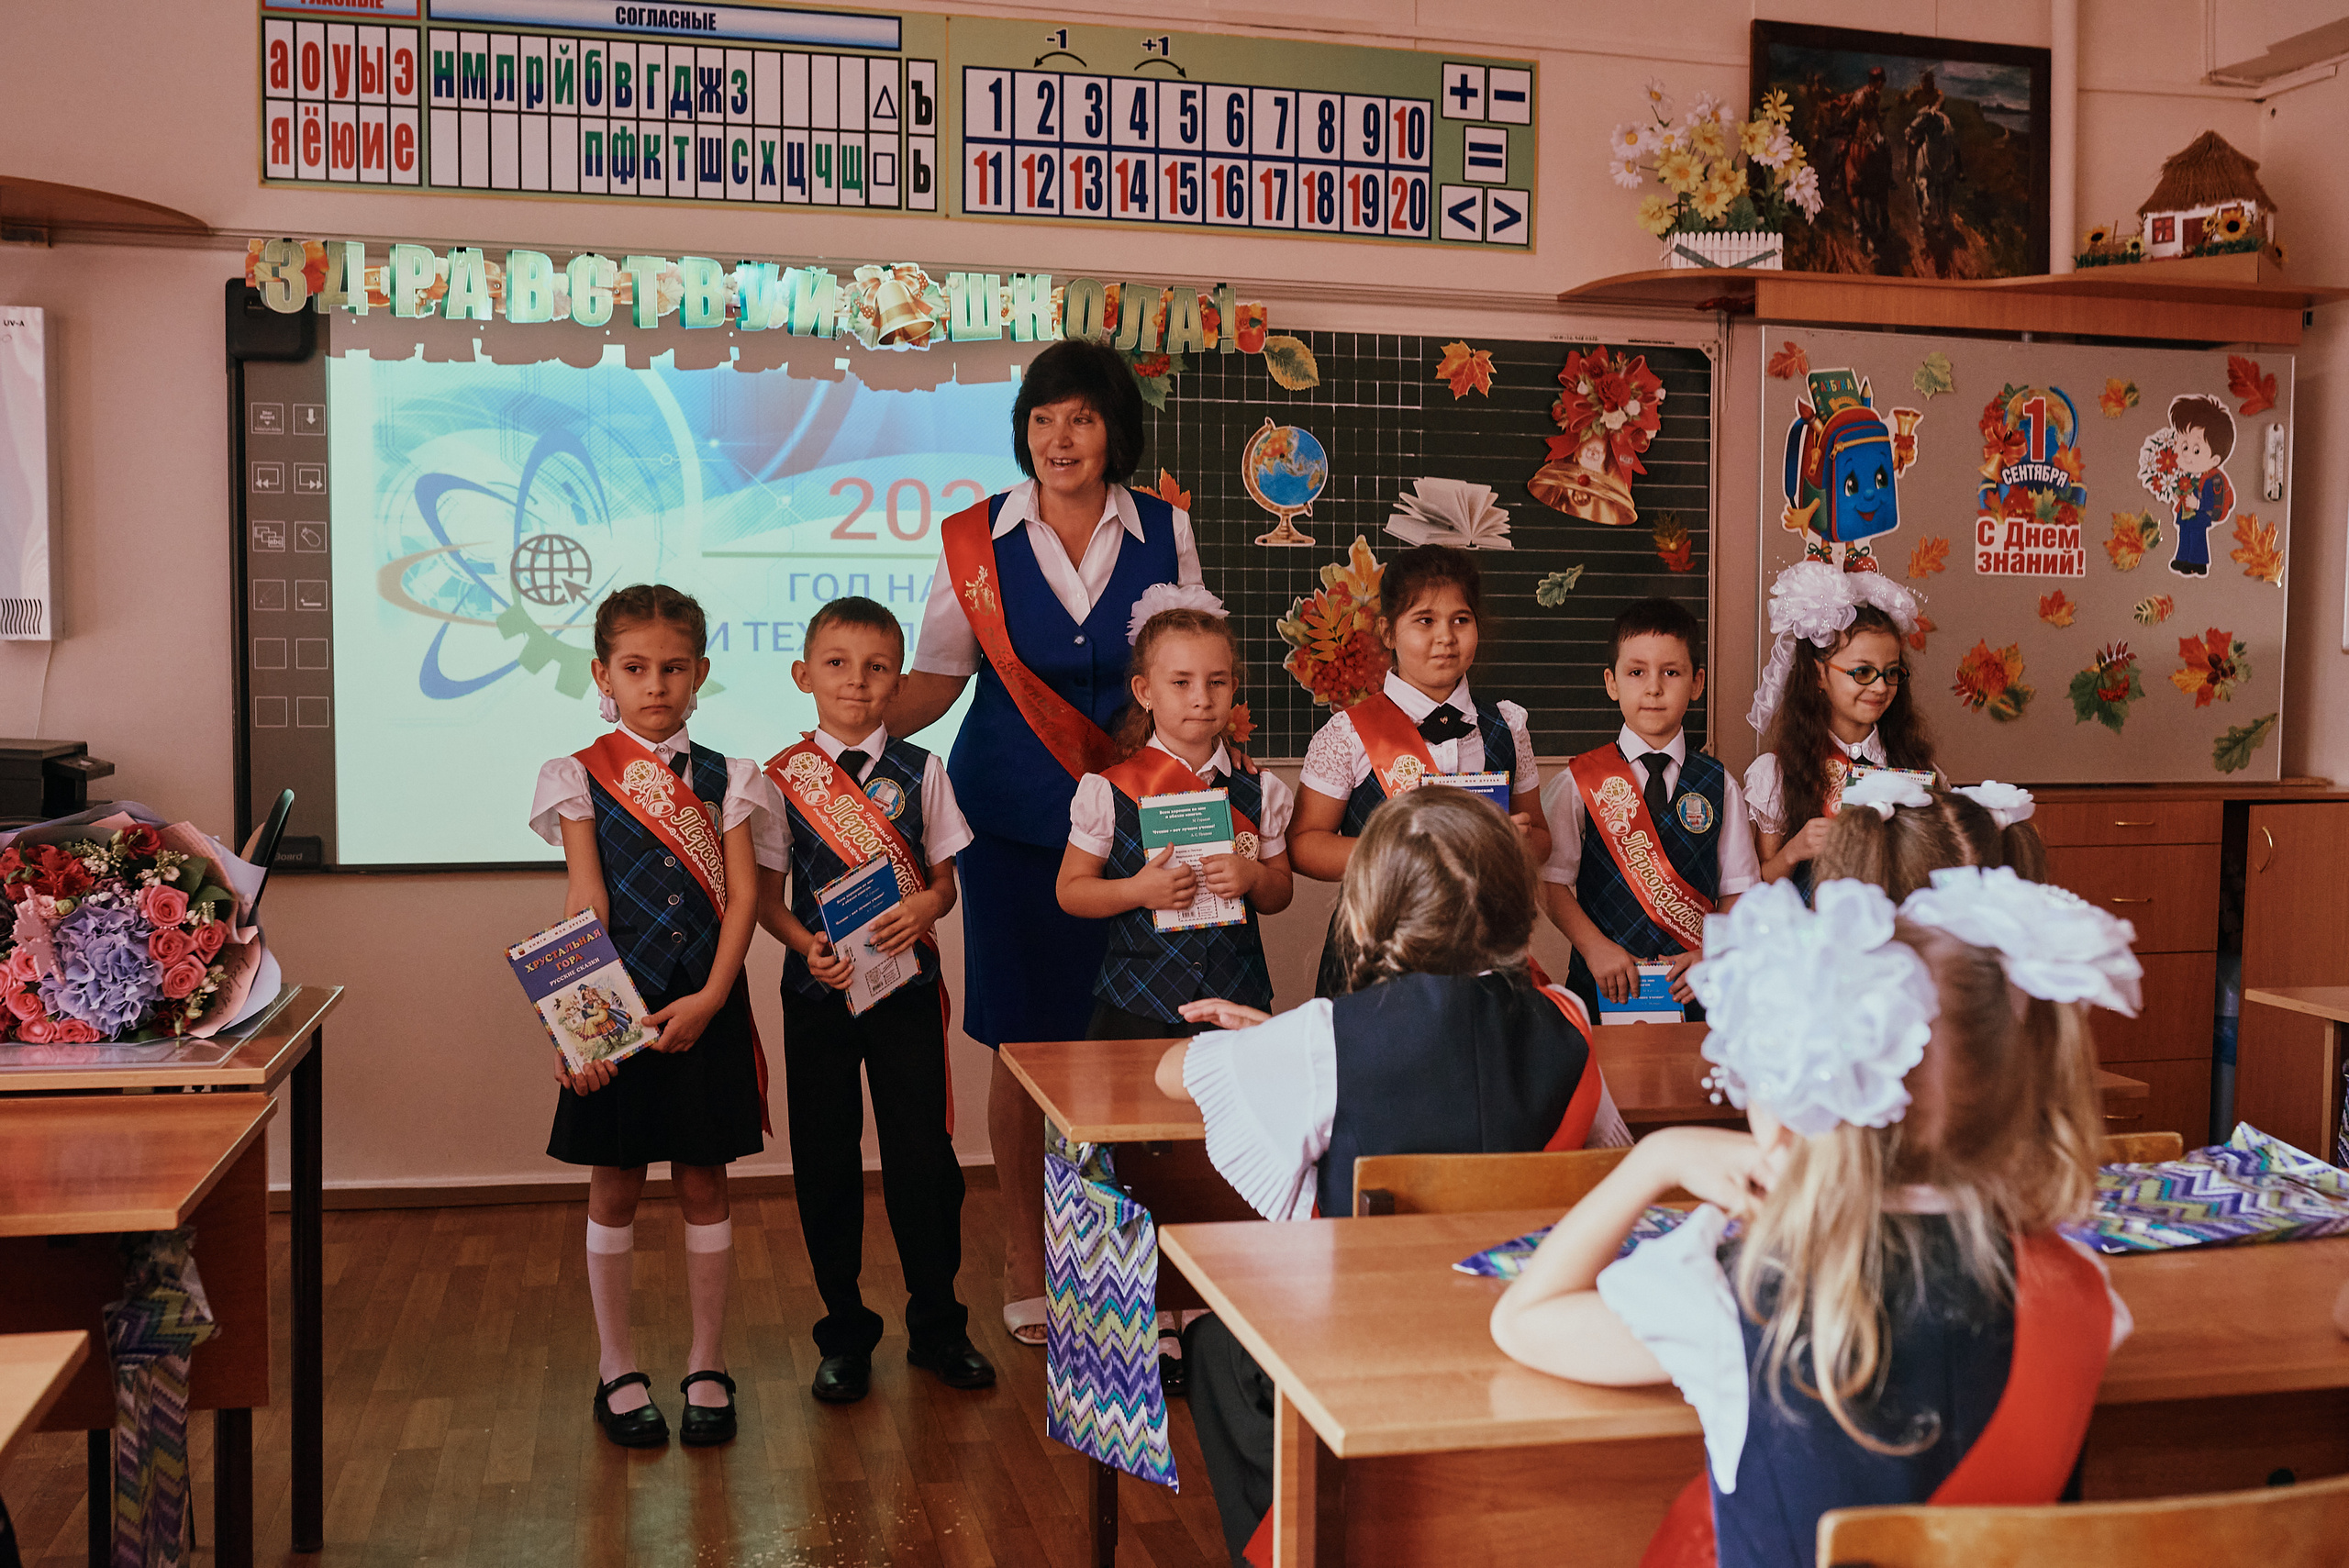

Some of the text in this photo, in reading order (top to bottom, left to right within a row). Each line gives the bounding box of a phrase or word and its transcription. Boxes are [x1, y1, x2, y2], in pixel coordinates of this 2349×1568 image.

[615, 6, 717, 31] СОГЛАСНЫЕ
[270, 39, 414, 99] а о у ы э
[989, 77, 1426, 161] 1 2 3 4 5 6 7 8 9 10
[271, 106, 415, 172] я ё ю и е
[974, 150, 1427, 232] 11 12 13 14 15 16 17 18 19 20
[945, 272, 1237, 354] ШКОЛА!
[1820, 378, 1854, 392] АЗБУКА
[2023, 396, 2045, 462] 1
[2001, 463, 2069, 488] СЕНТЯБРЯ
[1977, 520, 2079, 550] С Днем
[1978, 549, 2084, 575] знаний!
[789, 573, 870, 603] ГОД
[525, 928, 602, 973] ХРУСТАЛЬНАЯ
[555, 952, 584, 971] ГОРА
[549, 957, 600, 986] РУССКИЕ СКАЗКИ
